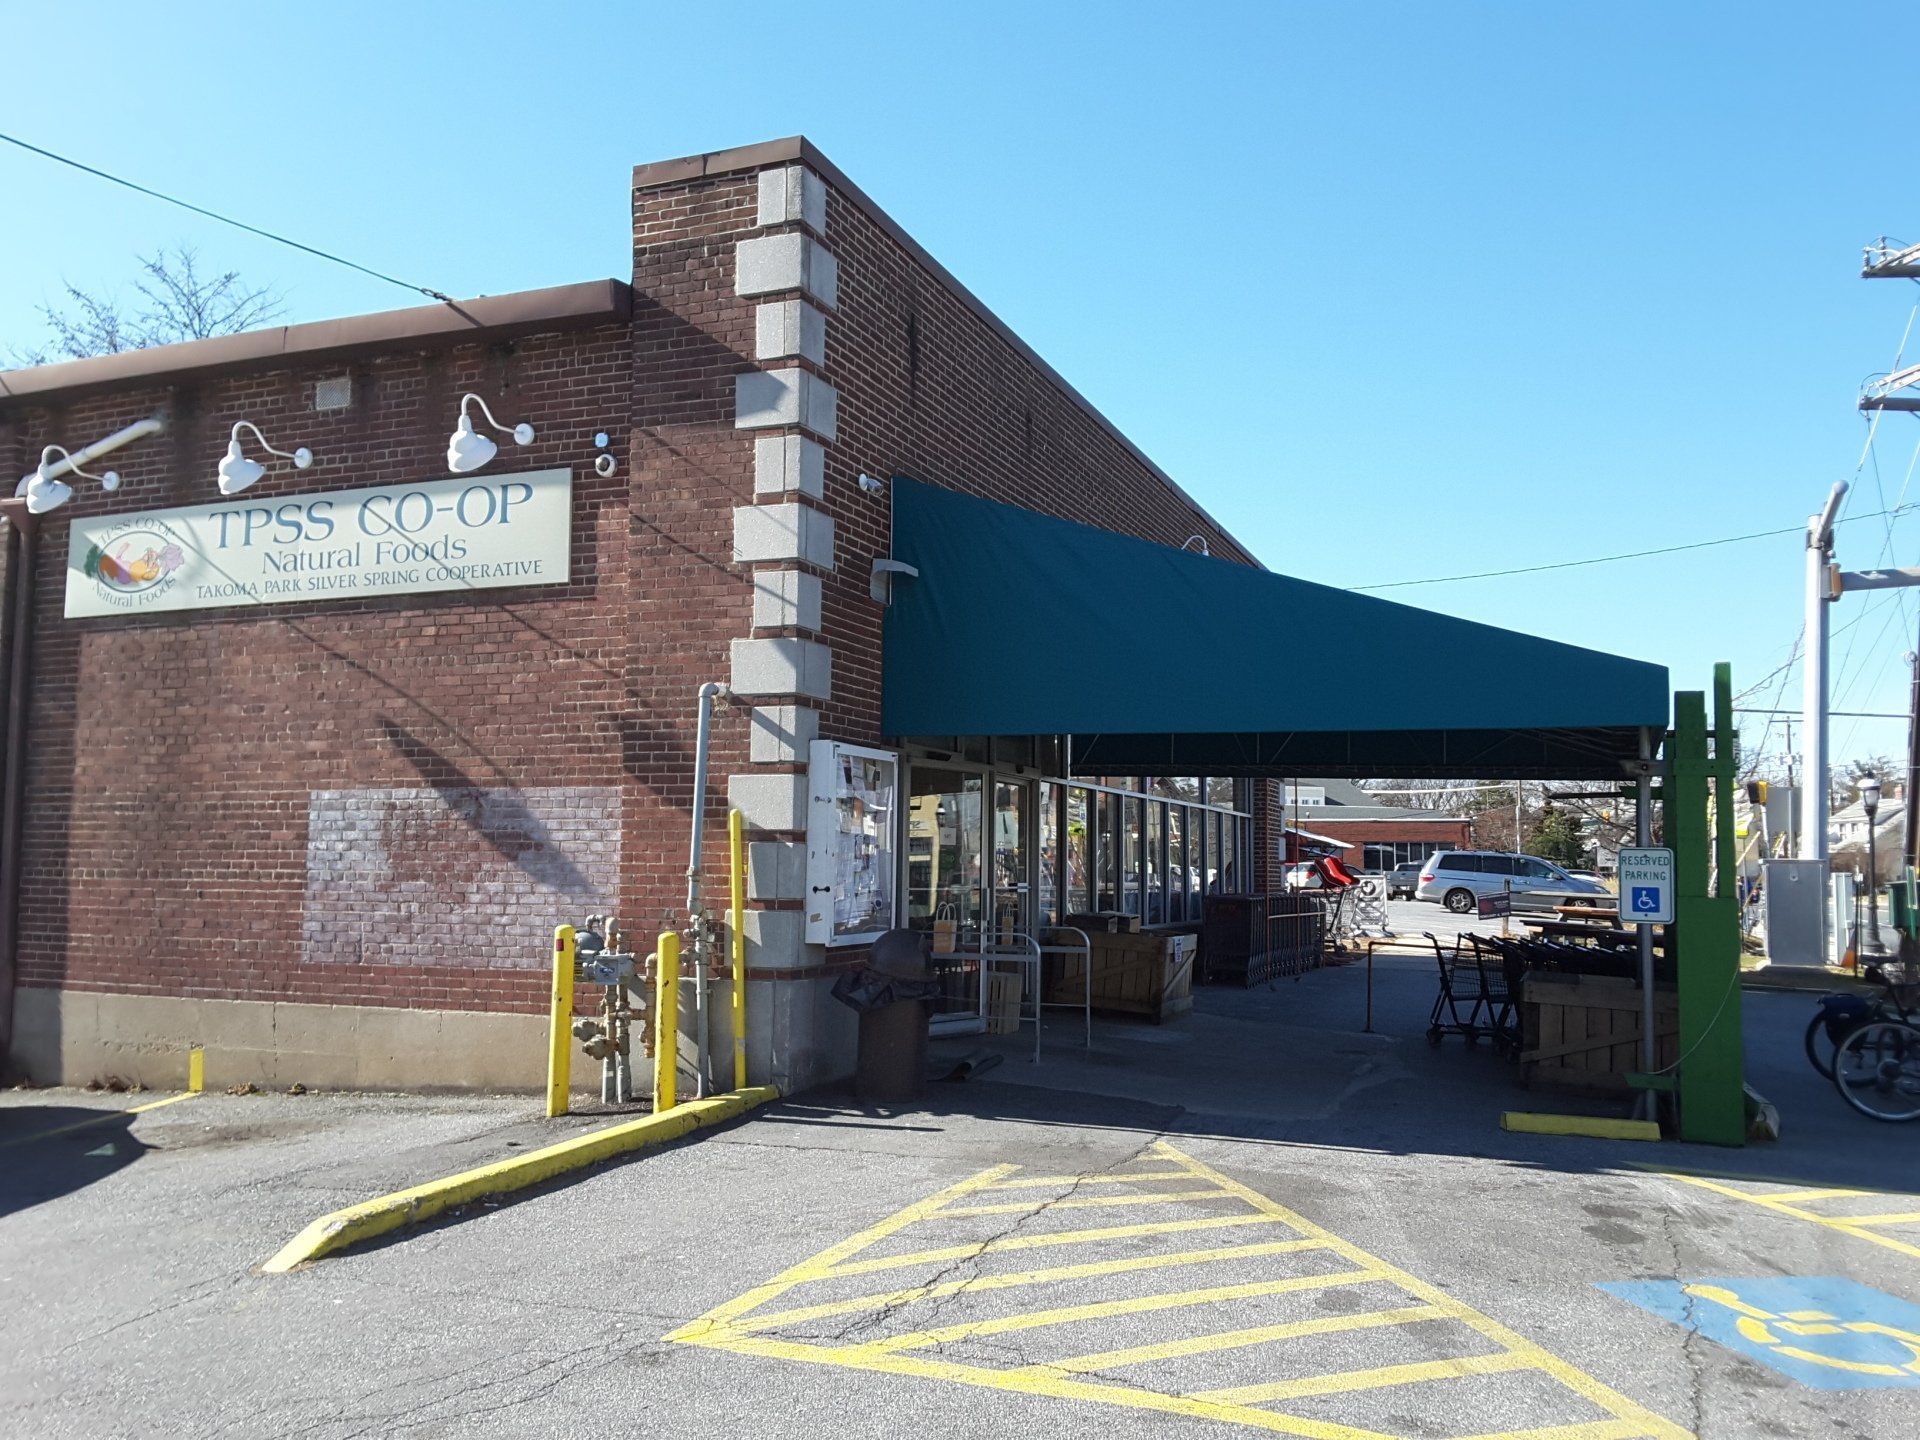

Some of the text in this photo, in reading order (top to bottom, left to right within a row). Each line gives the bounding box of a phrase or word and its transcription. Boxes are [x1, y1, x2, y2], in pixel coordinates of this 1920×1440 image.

[208, 482, 534, 549] TPSS CO-OP
[262, 534, 467, 574] Natural Foods
[92, 577, 176, 607] Natural Foods
[196, 560, 543, 598] TAKOMA PARK SILVER SPRING COOPERATIVE
[1621, 855, 1670, 866] RESERVED
[1625, 870, 1666, 881] PARKING
